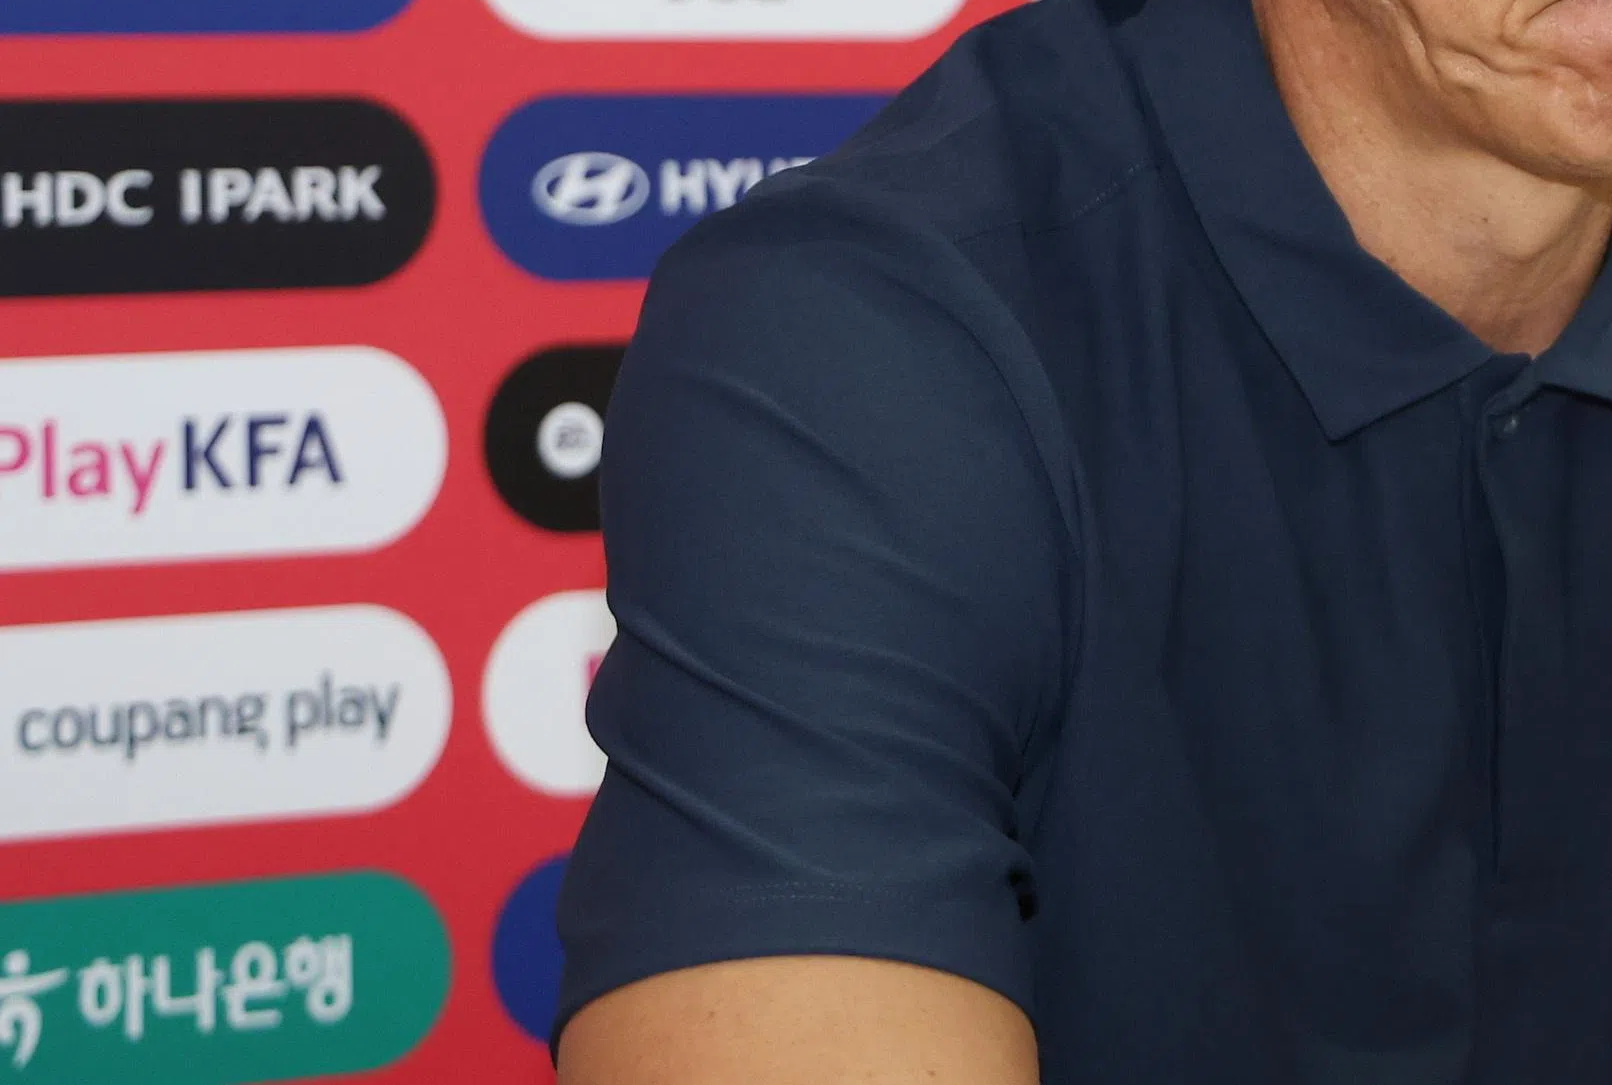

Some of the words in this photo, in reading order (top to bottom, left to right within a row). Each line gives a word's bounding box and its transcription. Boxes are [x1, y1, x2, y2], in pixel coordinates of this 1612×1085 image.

[3, 169, 153, 227] HDC
[180, 166, 386, 224] IPARK
[16, 692, 271, 764] coupang
[284, 671, 401, 749] play
[77, 933, 354, 1040] 하나은행
